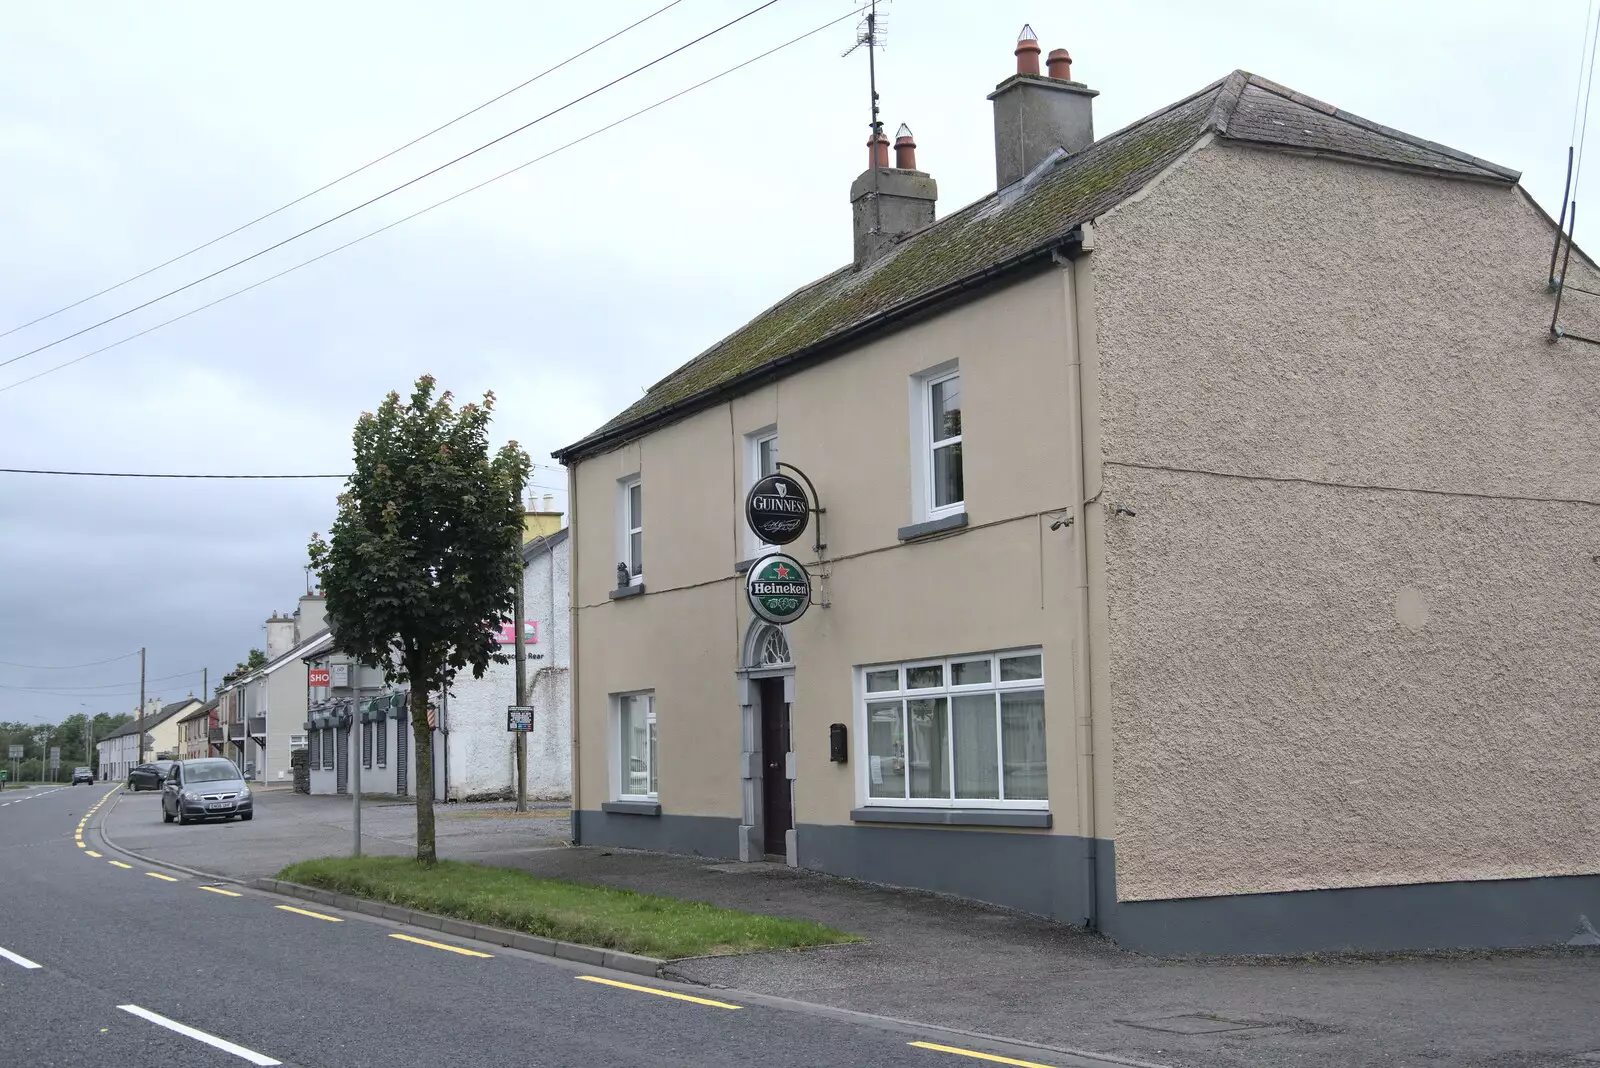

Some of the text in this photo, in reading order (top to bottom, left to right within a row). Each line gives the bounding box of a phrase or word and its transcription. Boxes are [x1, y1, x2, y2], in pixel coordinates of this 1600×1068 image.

[753, 497, 805, 513] GUINNESS
[754, 582, 807, 594] Heineken
[528, 652, 544, 660] Rear
[310, 673, 330, 682] SHO
